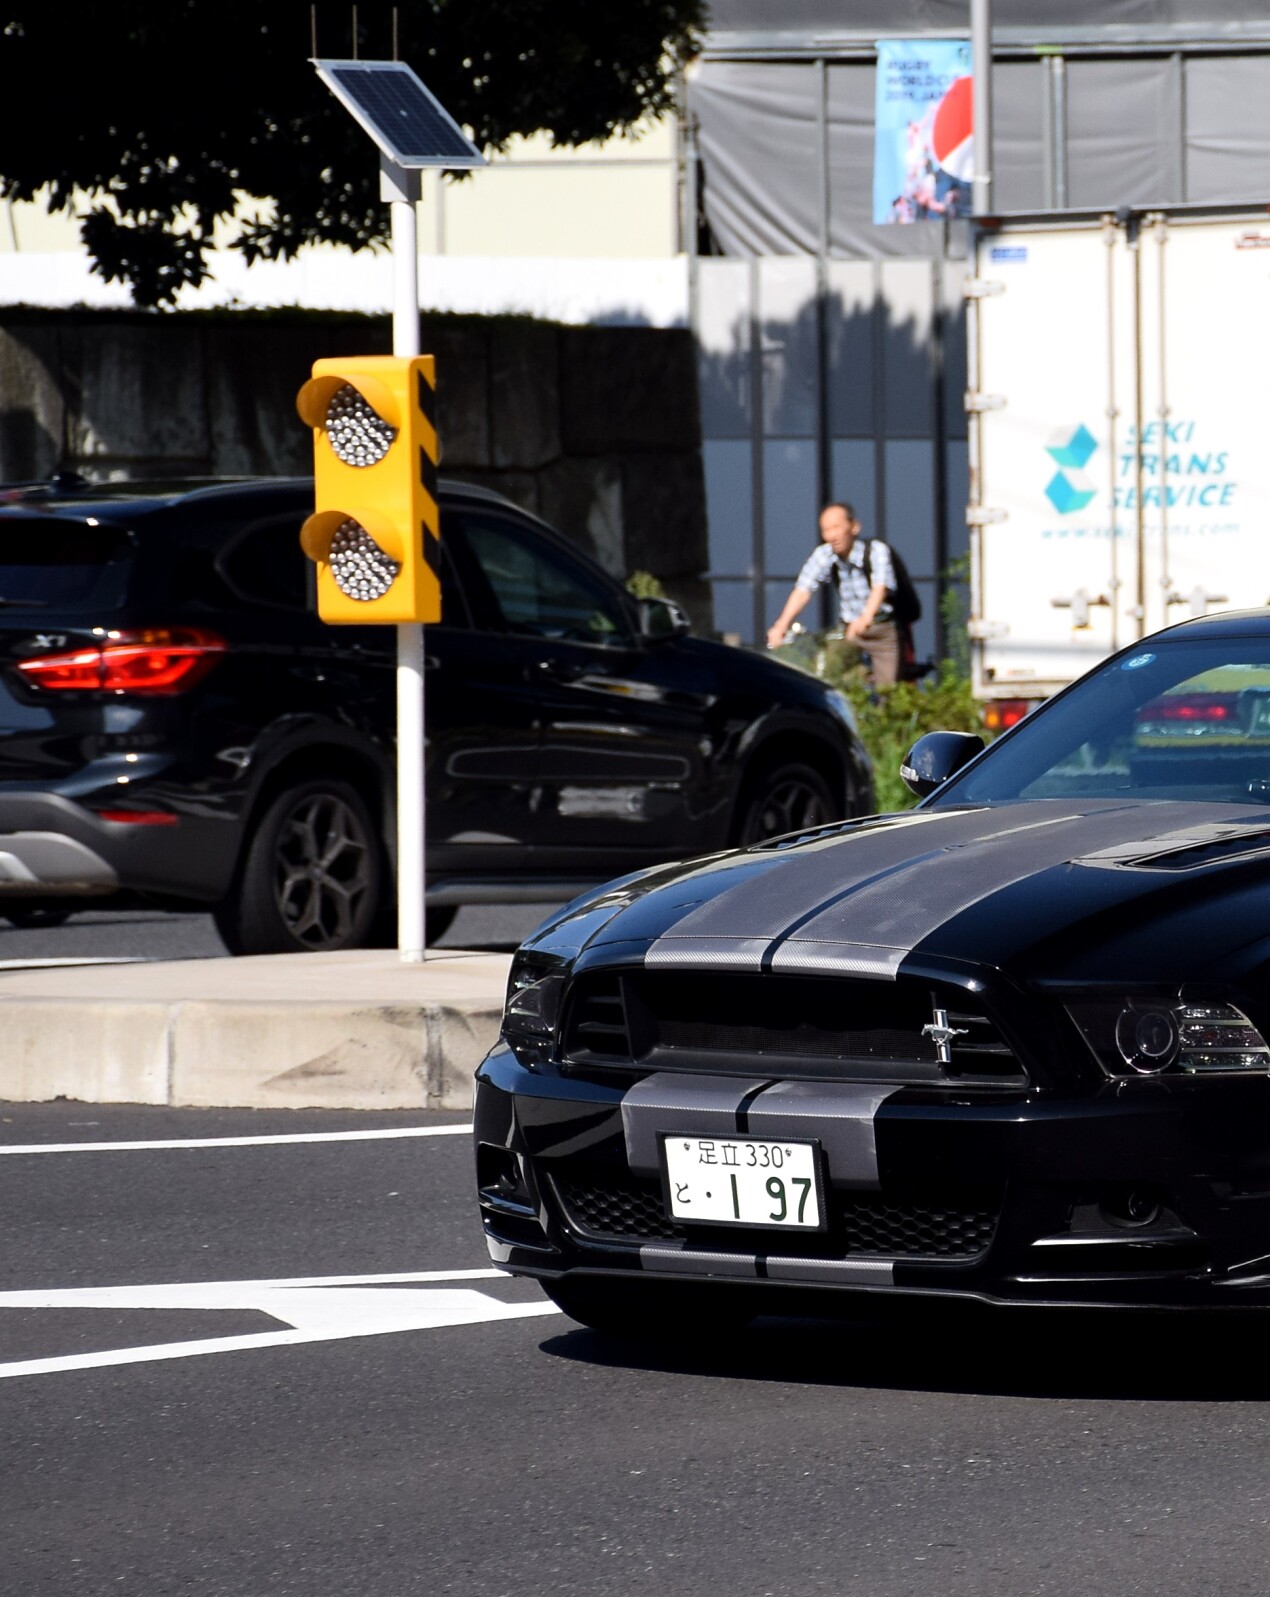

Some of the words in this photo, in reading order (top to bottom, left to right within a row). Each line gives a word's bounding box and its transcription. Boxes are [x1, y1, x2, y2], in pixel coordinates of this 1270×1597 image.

[1126, 421, 1196, 445] SEKI
[1120, 452, 1228, 476] TRANS
[1109, 483, 1237, 508] SERVICE
[675, 1182, 692, 1204] と
